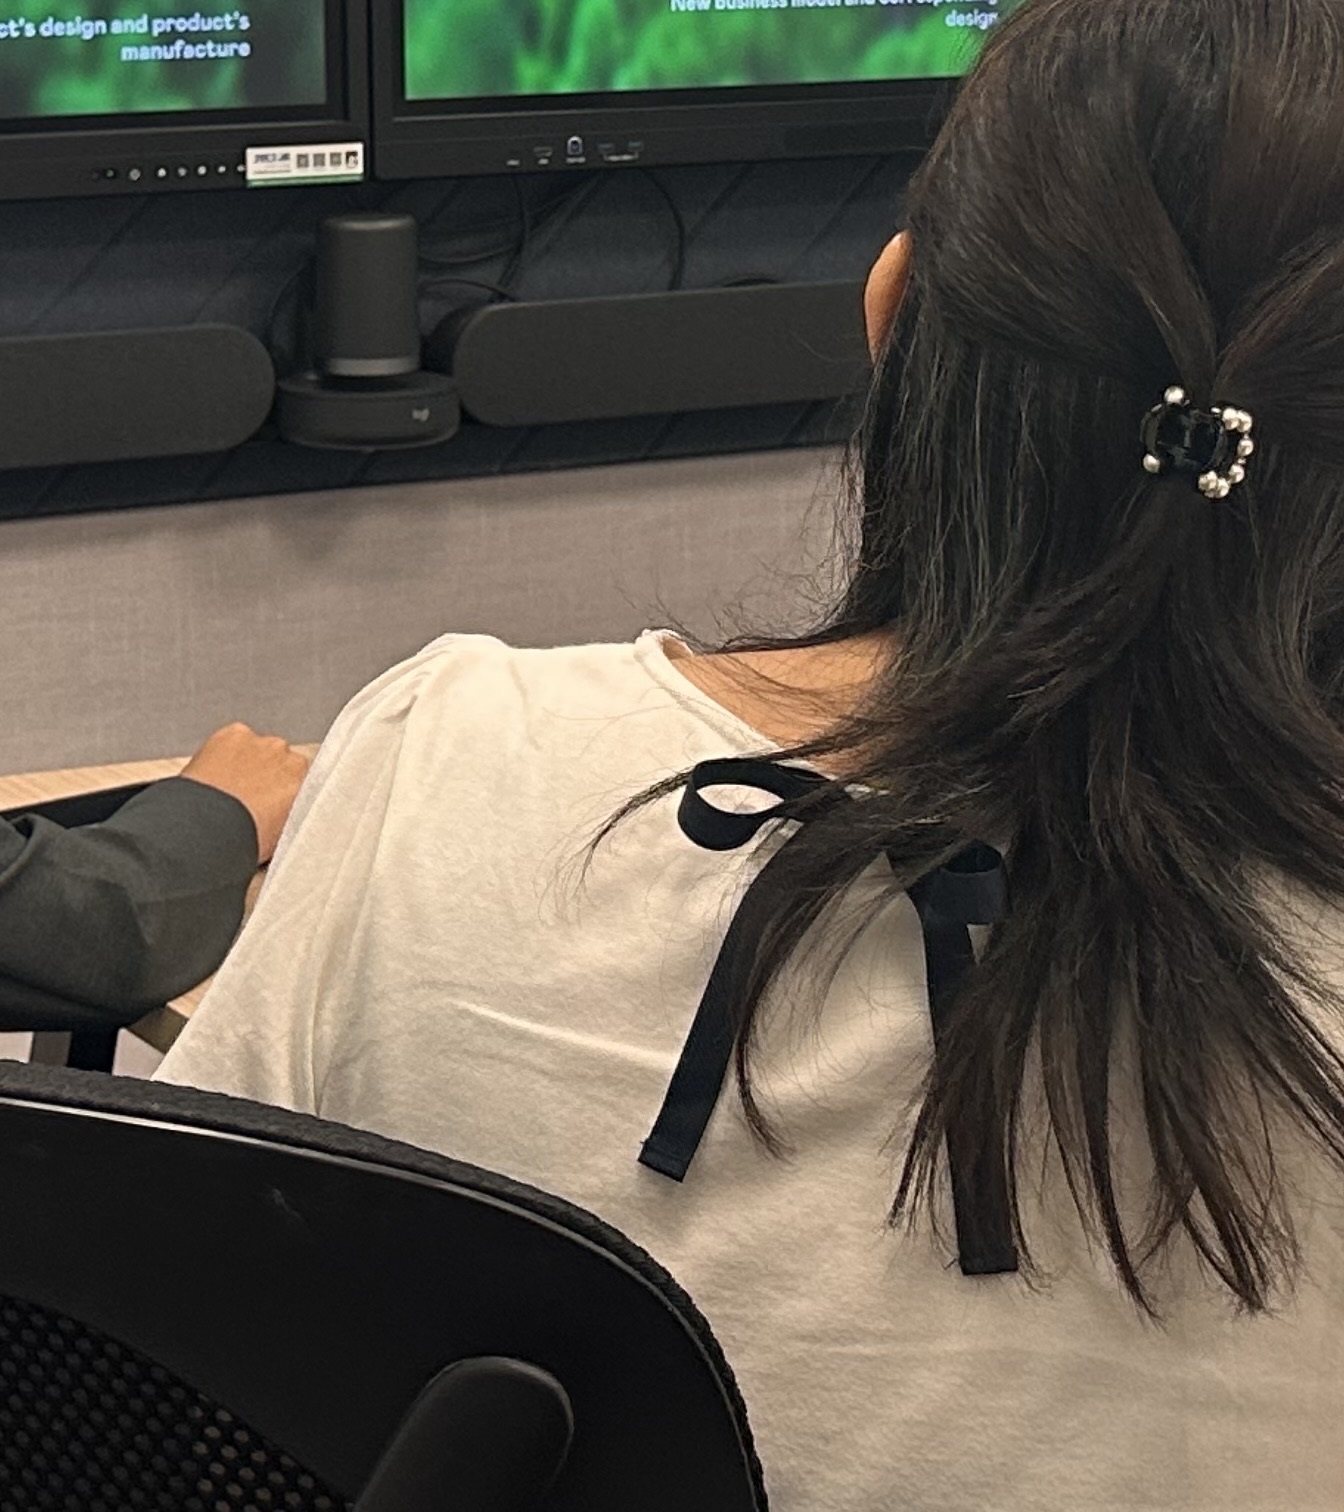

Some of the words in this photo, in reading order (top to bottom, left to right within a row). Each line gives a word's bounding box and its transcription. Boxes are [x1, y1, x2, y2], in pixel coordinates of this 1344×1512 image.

[39, 16, 107, 40] design
[110, 14, 148, 35] and
[152, 11, 250, 36] product's
[120, 39, 251, 62] manufacture
